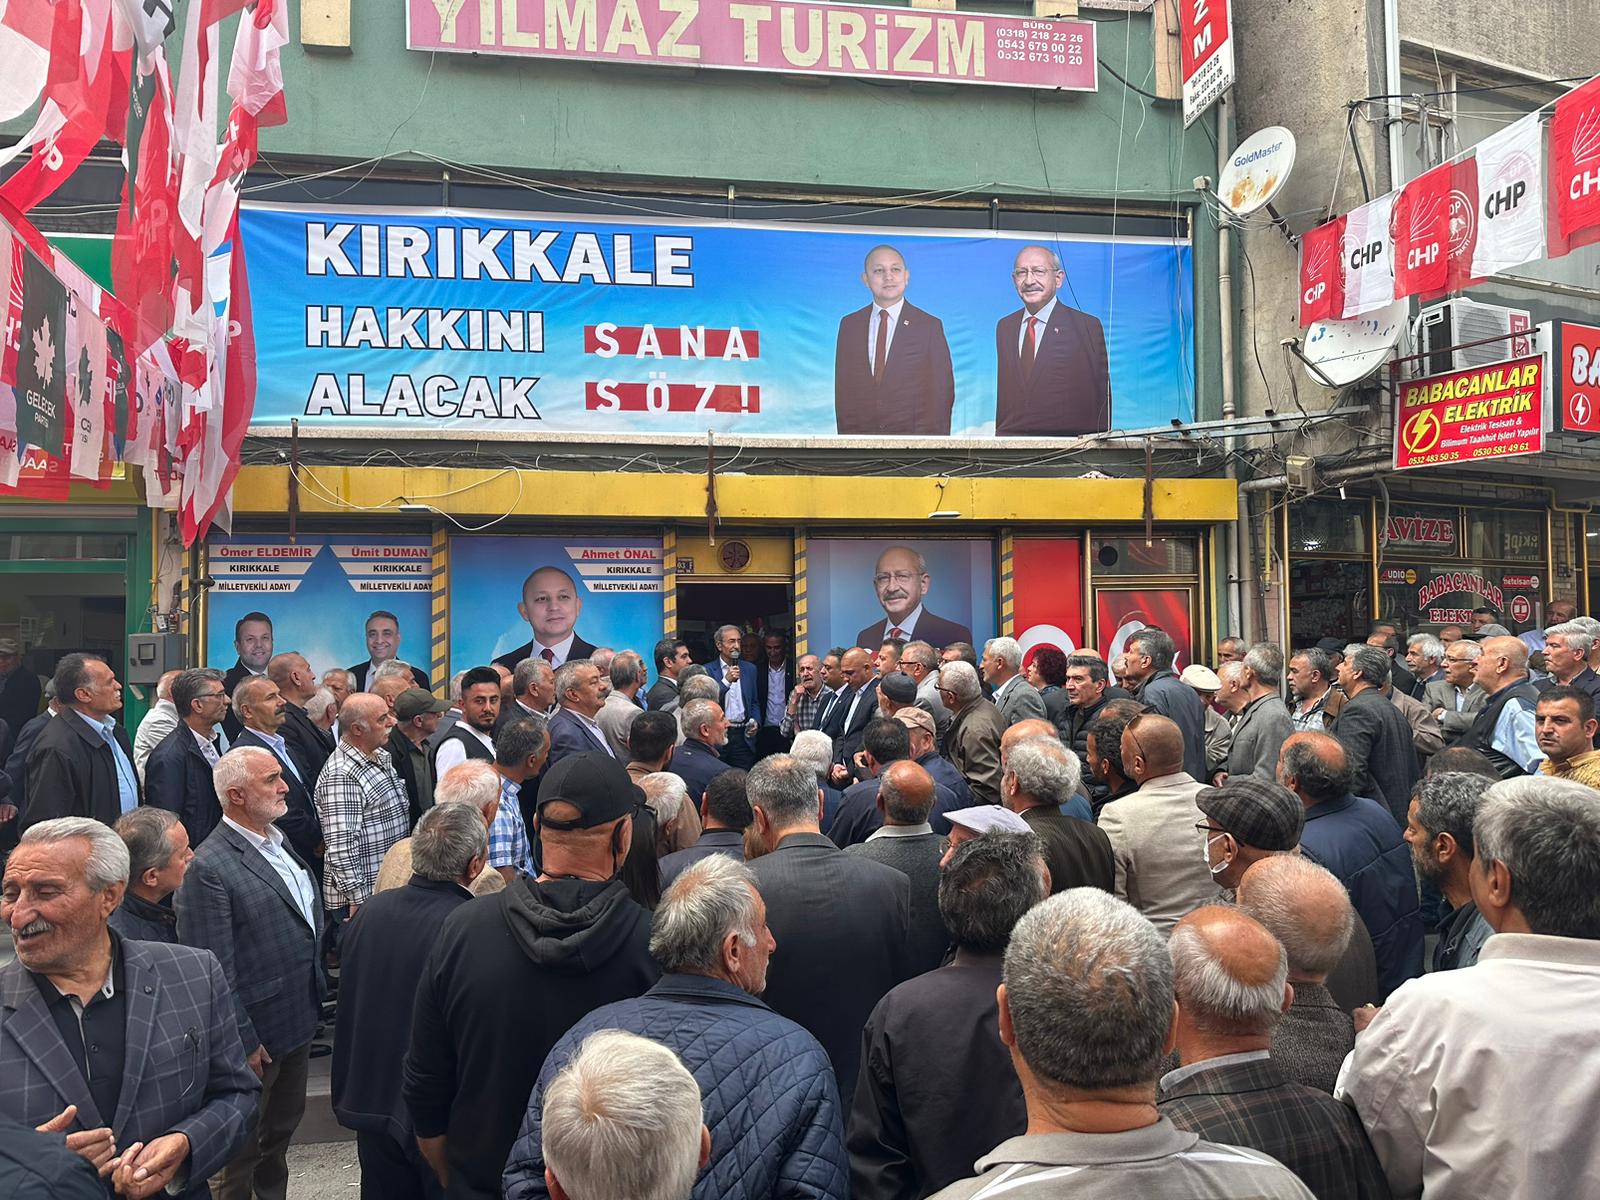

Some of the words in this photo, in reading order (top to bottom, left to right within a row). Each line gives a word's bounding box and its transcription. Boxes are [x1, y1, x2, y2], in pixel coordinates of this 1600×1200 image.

[1022, 21, 1053, 30] BÜRO
[996, 28, 1028, 40] (0318)
[1031, 31, 1050, 40] 218
[1053, 32, 1067, 42] 22
[1070, 34, 1084, 43] 26
[997, 39, 1025, 50] 0543
[1028, 41, 1048, 52] 679
[1051, 44, 1065, 53] 00
[1068, 45, 1082, 54] 22
[1029, 52, 1050, 63] 673
[1053, 54, 1065, 64] 10
[1068, 55, 1083, 65] 20
[1234, 141, 1282, 167] GoldMaster
[1484, 180, 1526, 220] CHP
[305, 221, 695, 288] KIRIKKALE
[1350, 240, 1383, 270] CHP
[1407, 241, 1439, 270] CHP
[1304, 281, 1326, 305] CHP
[305, 305, 545, 353] HAKKINI
[594, 321, 750, 362] SANA
[1405, 364, 1539, 408] BABACANLAR
[304, 373, 541, 420] ALACAK
[1442, 389, 1535, 424] ELEKTRİK
[1516, 416, 1522, 425] &
[1379, 511, 1455, 543] AVİZE
[220, 547, 254, 557] Ömer
[256, 546, 312, 557] ELDEMİR
[351, 546, 381, 557] Ümit
[383, 548, 428, 557] DUMAN
[581, 549, 620, 559] Ahmet
[623, 548, 656, 559] ÖNAL
[229, 564, 280, 573] KIRIKKALE
[373, 564, 422, 573] KIRIKKALE
[606, 566, 652, 574] KIRIKKALE
[218, 582, 269, 591] MİLLETVEKİLİ
[269, 582, 291, 591] ADAYI
[360, 582, 412, 591] MİLLETVEKİLİ
[593, 581, 638, 591] MİLLETVEKİLİ
[639, 582, 658, 591] ADAYI
[1418, 572, 1504, 613] BABACANLAR
